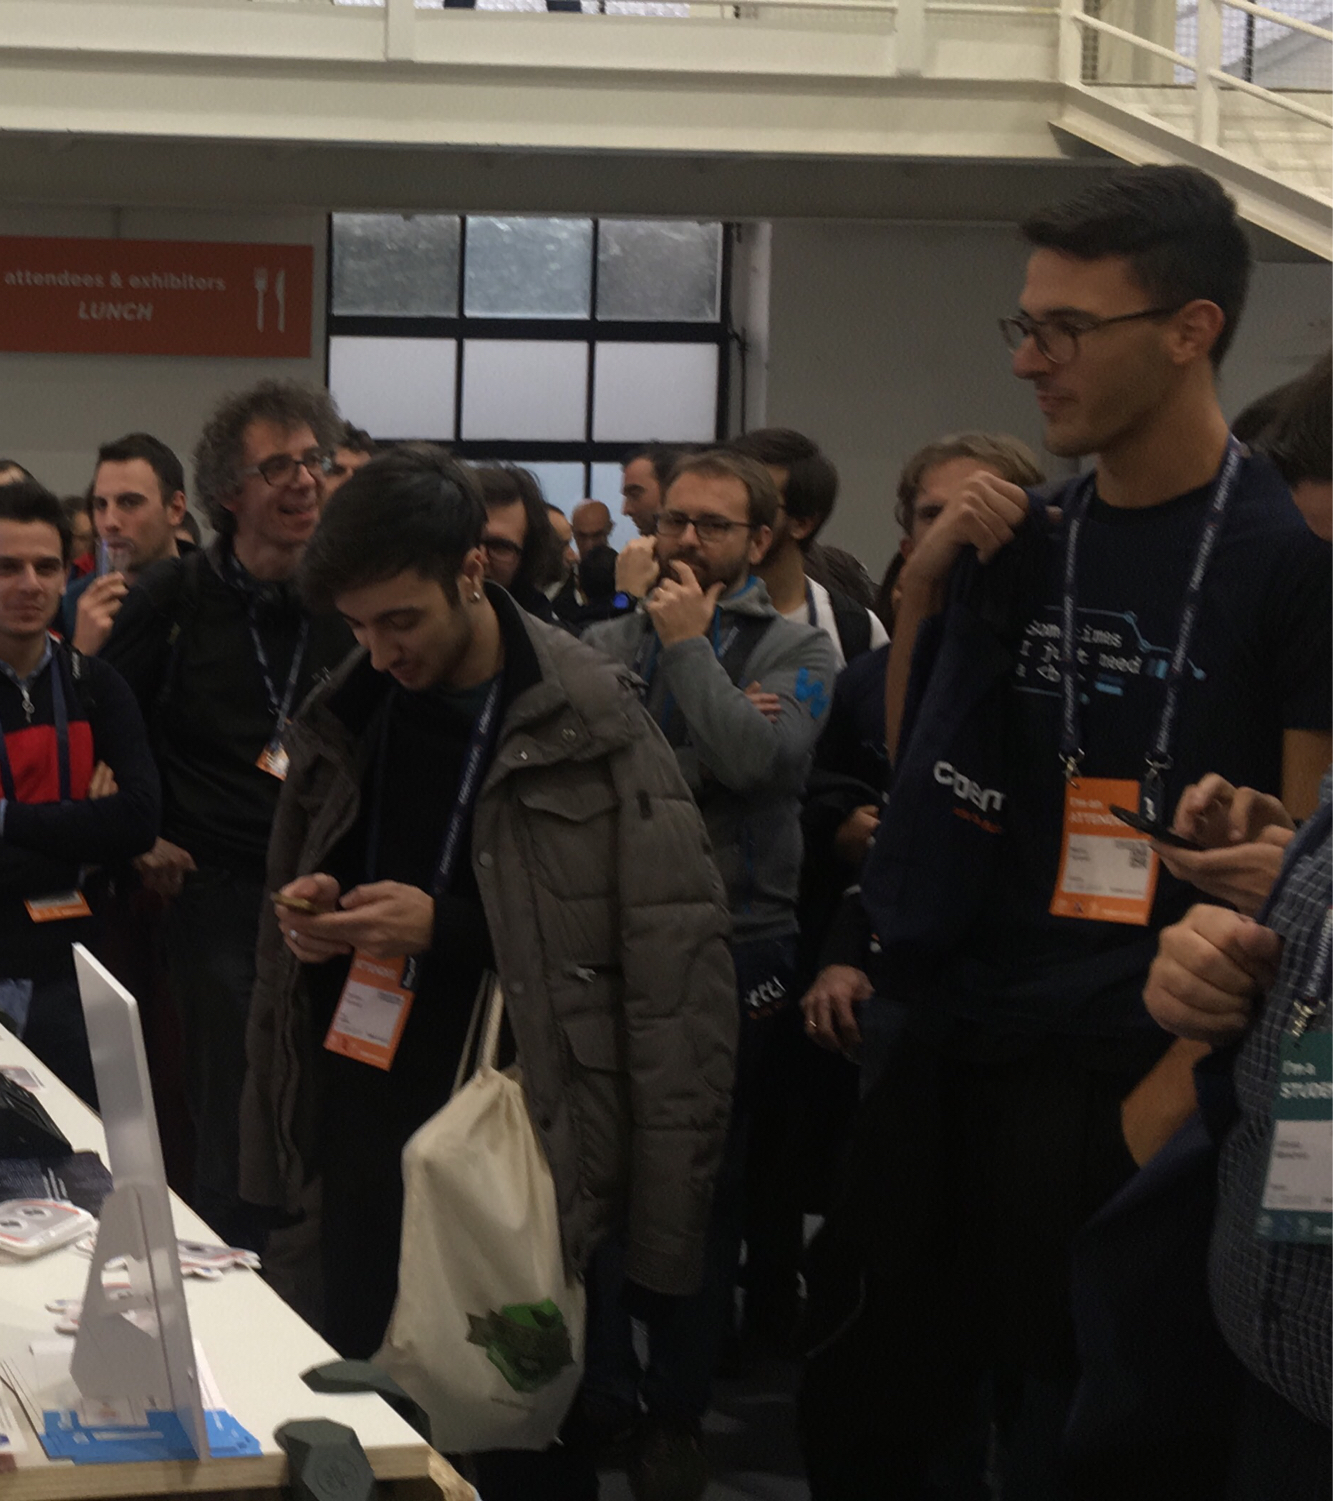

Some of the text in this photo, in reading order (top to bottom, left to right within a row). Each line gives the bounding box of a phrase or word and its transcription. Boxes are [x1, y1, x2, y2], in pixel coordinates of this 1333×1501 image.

[4, 268, 227, 292] attendees & exhibitors
[77, 301, 154, 323] LUNCH
[1040, 641, 1090, 666] jut
